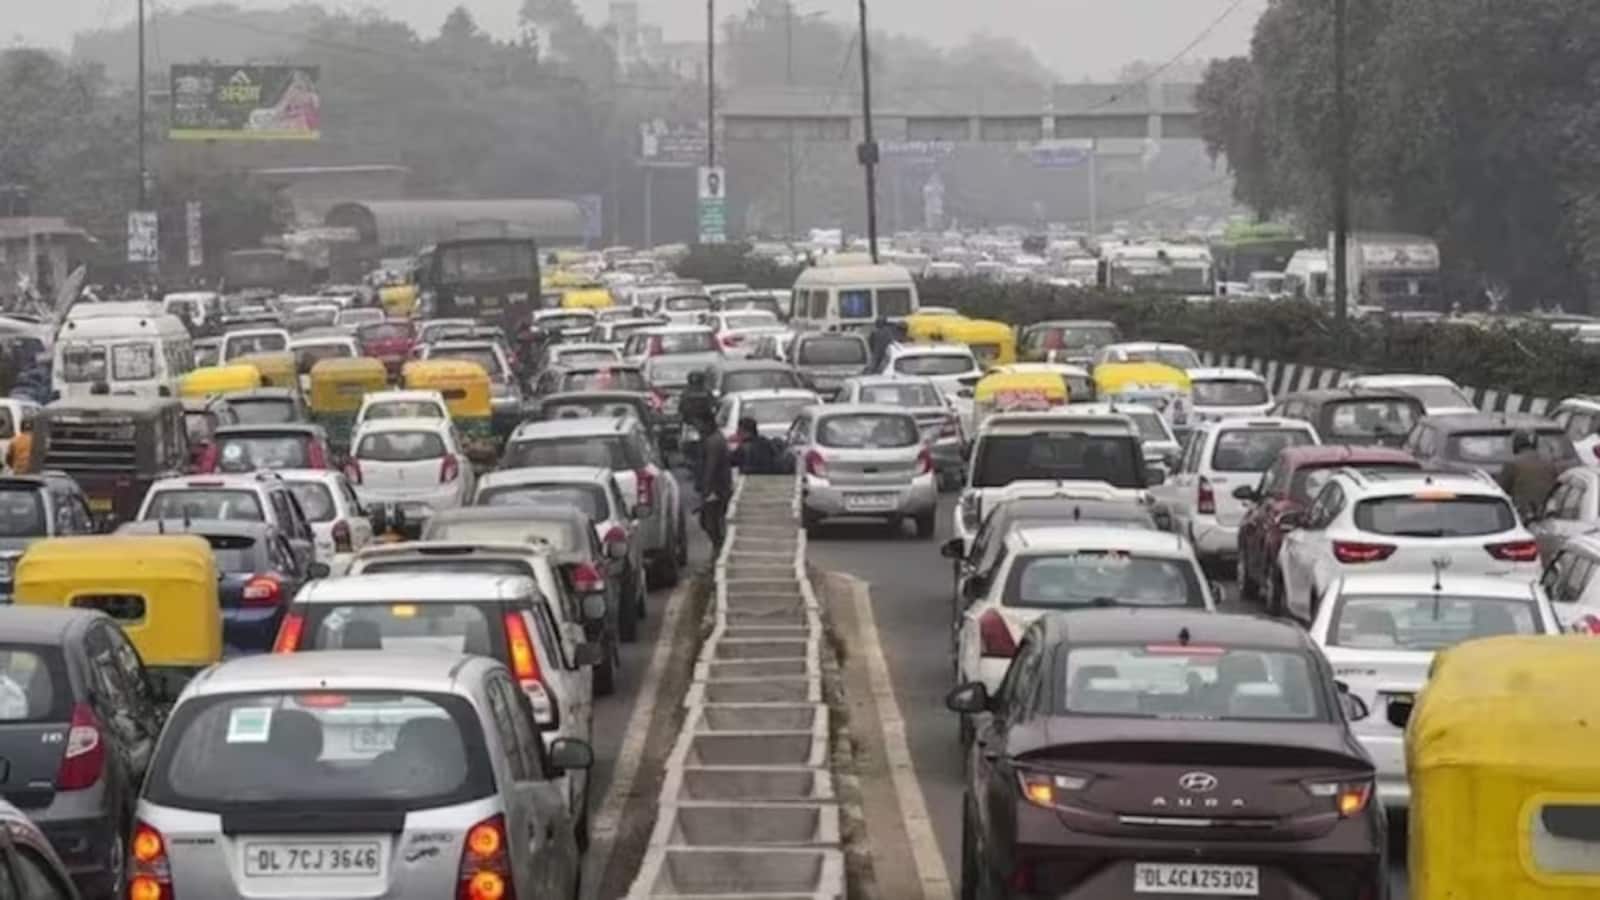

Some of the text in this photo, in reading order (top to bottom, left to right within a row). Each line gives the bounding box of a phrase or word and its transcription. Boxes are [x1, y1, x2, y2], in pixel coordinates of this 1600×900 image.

[257, 849, 377, 870] DL 7CJ 3646
[1144, 868, 1256, 889] DL4CA25302
